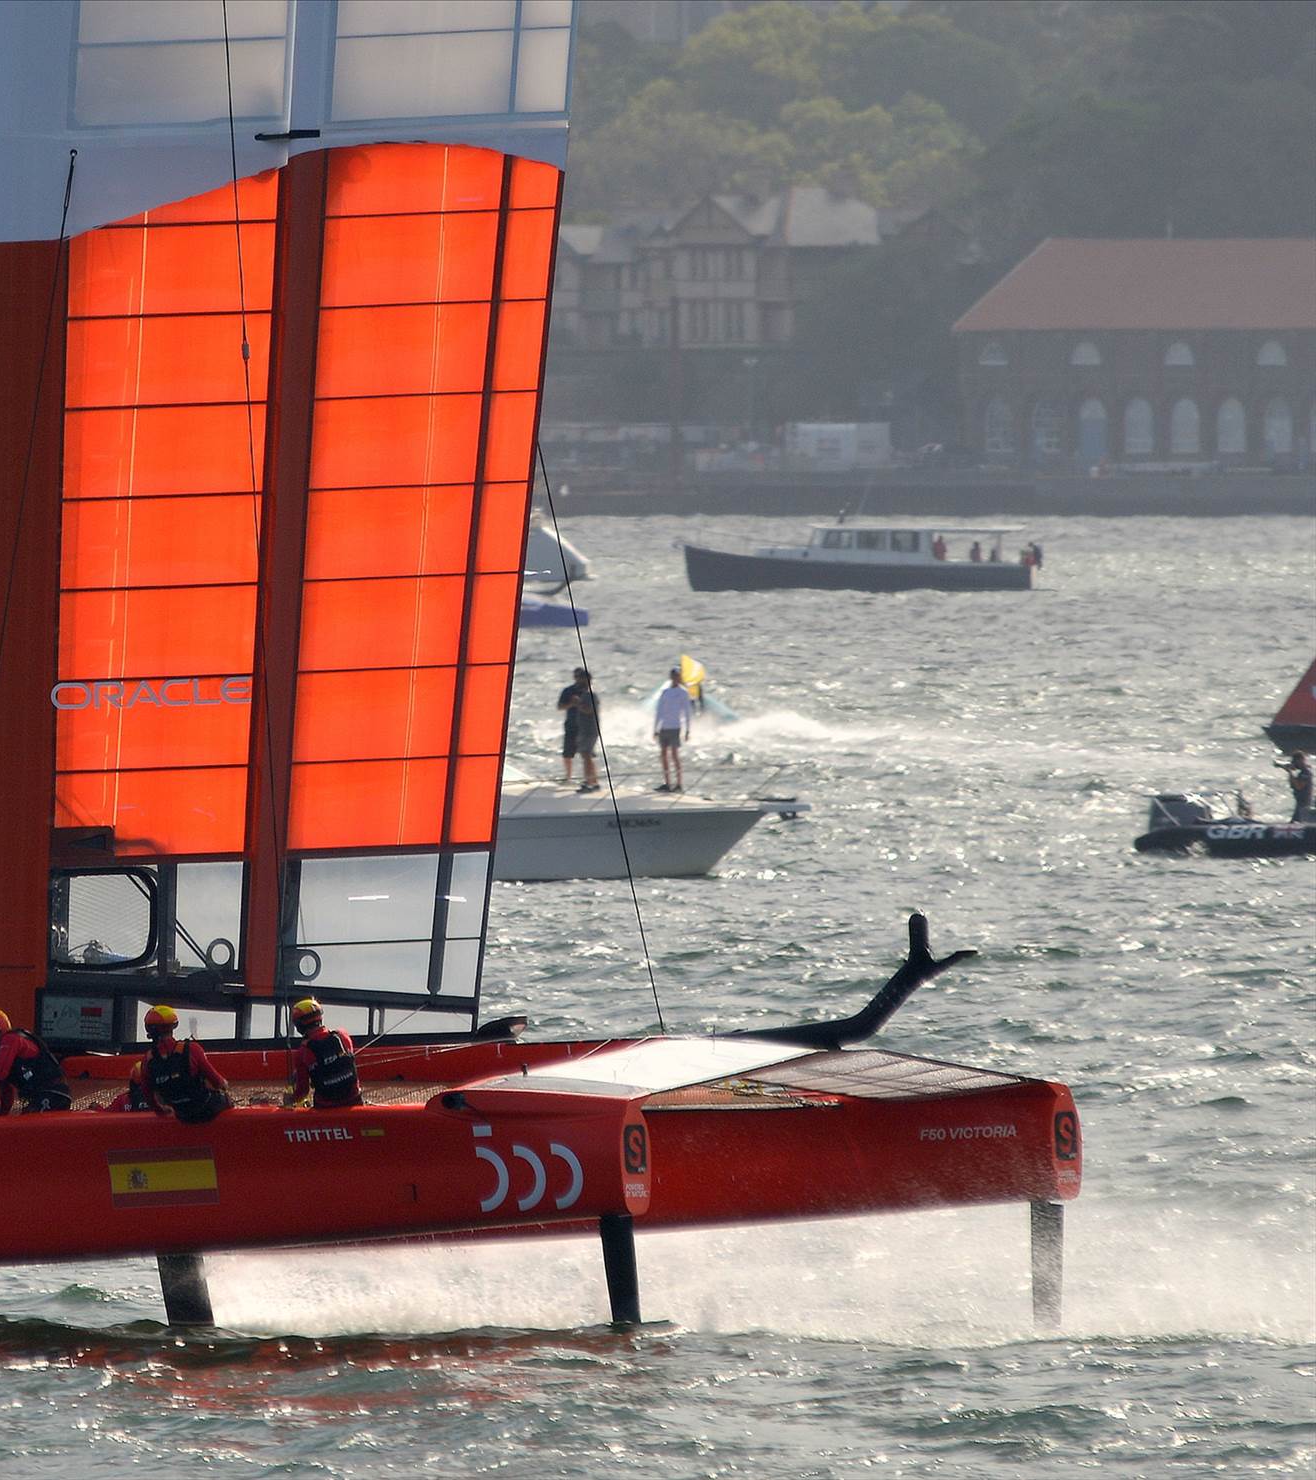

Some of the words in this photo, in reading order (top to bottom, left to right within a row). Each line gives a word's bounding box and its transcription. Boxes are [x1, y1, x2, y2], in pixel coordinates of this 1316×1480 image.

[50, 676, 253, 710] ORACLE
[1206, 824, 1268, 840] GBR
[284, 1128, 354, 1142] TRITTEL
[920, 1128, 946, 1141] F50
[949, 1125, 1017, 1140] VICTORIA
